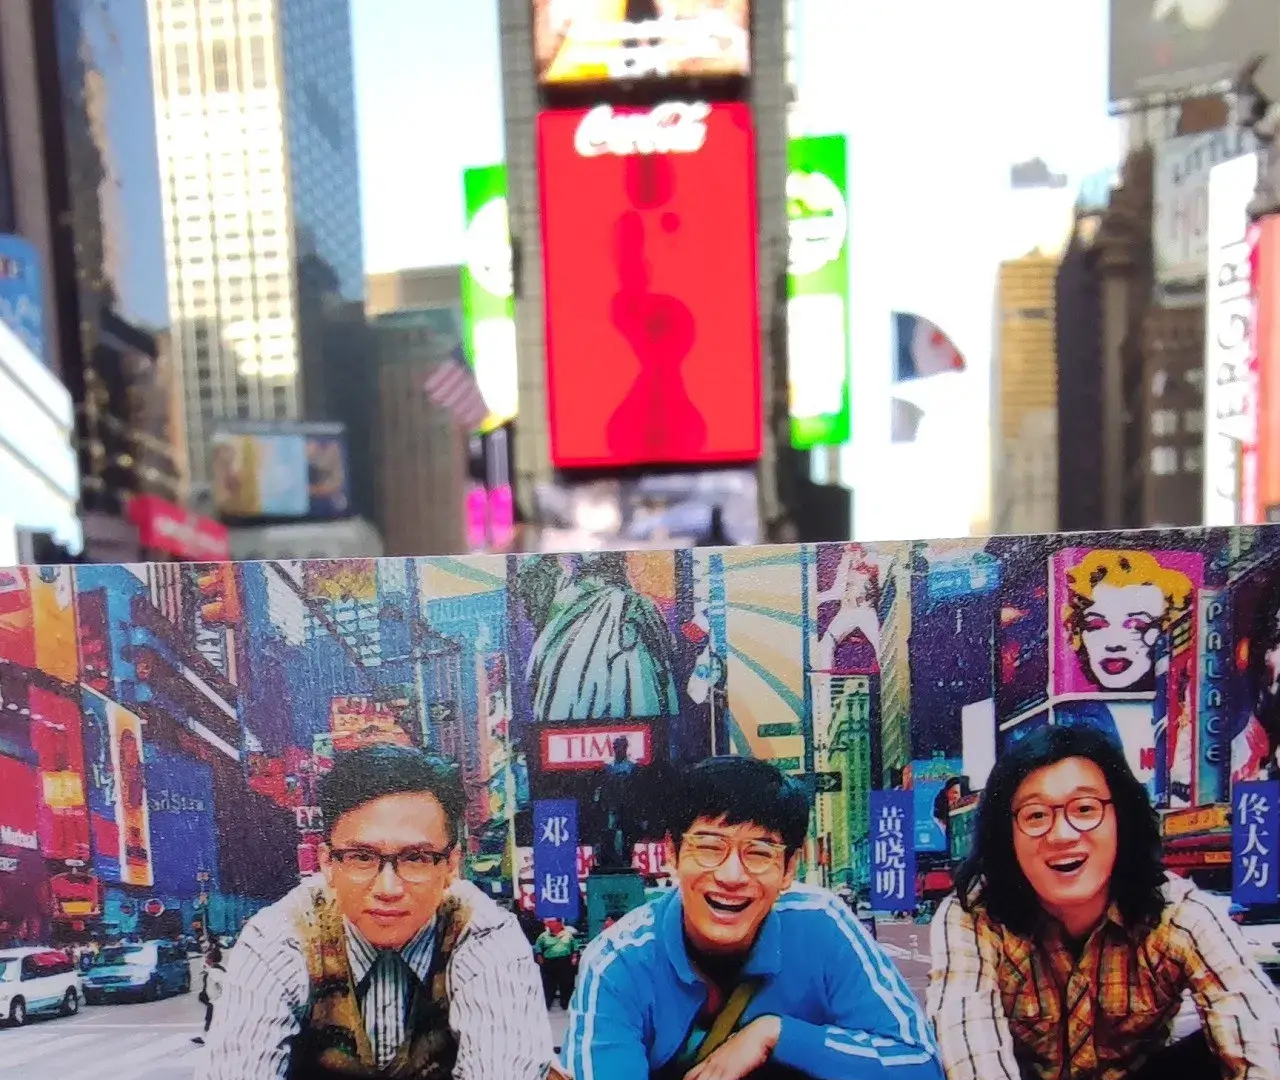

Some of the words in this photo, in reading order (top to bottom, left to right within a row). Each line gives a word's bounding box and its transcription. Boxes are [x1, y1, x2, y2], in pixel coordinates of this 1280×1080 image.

[540, 816, 570, 904] 邓超
[875, 805, 907, 900] 黄晓明
[1237, 792, 1271, 888] 佟大为
